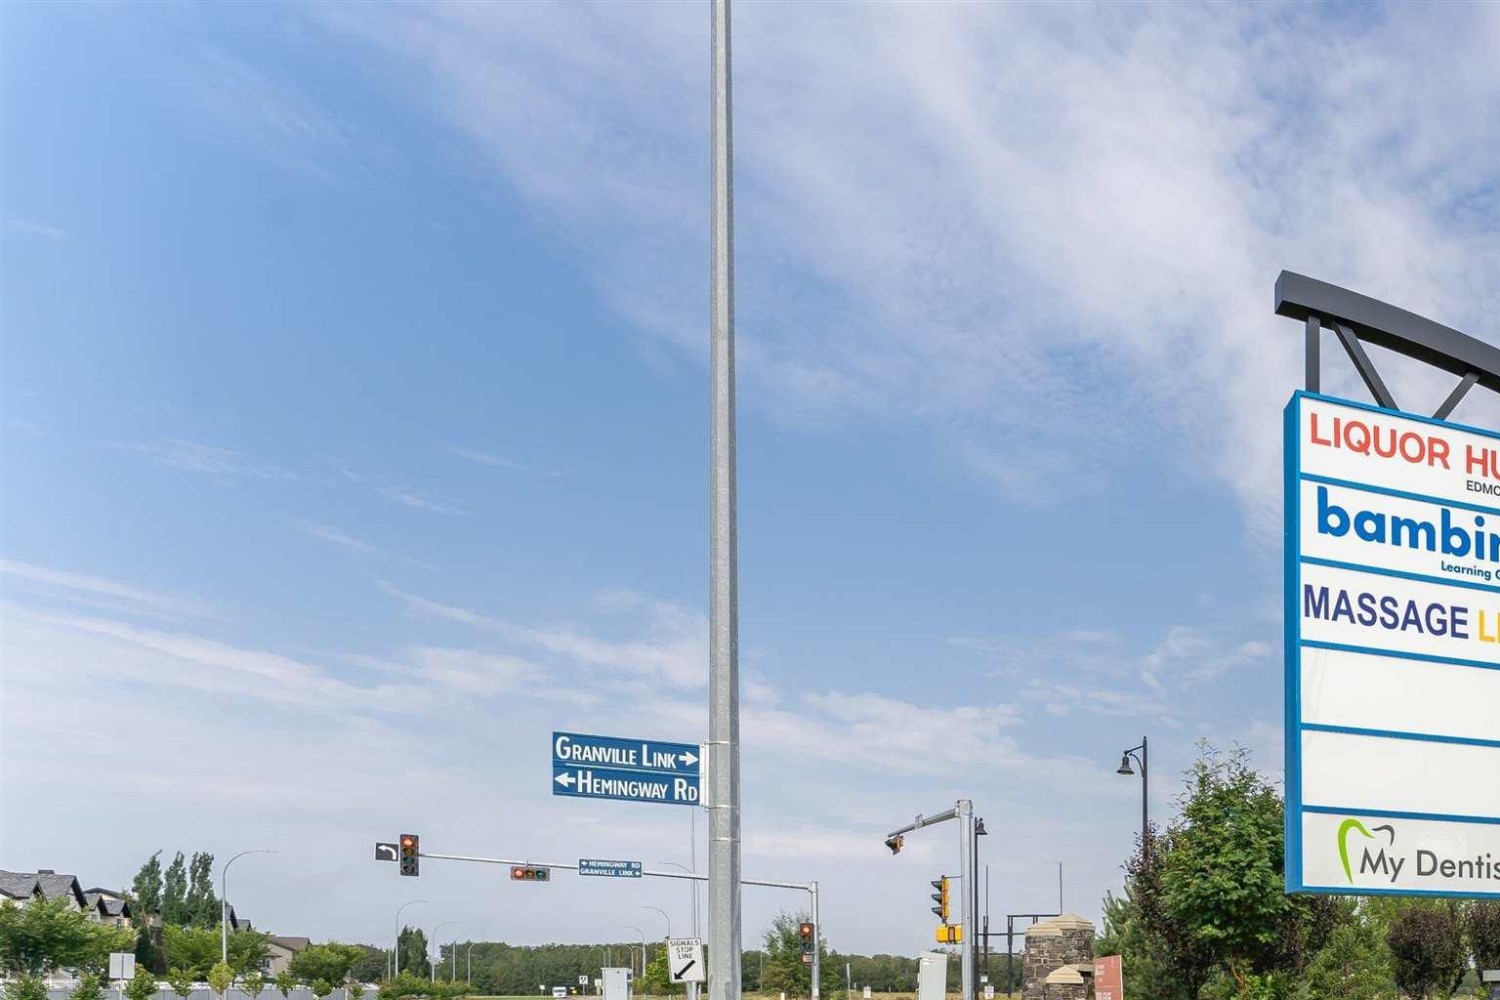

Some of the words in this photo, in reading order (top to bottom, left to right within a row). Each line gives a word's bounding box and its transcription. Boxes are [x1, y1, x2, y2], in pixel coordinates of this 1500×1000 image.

[1310, 412, 1450, 470] LIQUOR
[1441, 560, 1492, 581] Learning
[1303, 583, 1469, 639] MASSAGE
[555, 736, 637, 766] GRANVILLE
[642, 744, 677, 769] LINK
[577, 770, 668, 799] HEMINGWAY
[674, 778, 698, 801] RD
[1359, 846, 1405, 883] My
